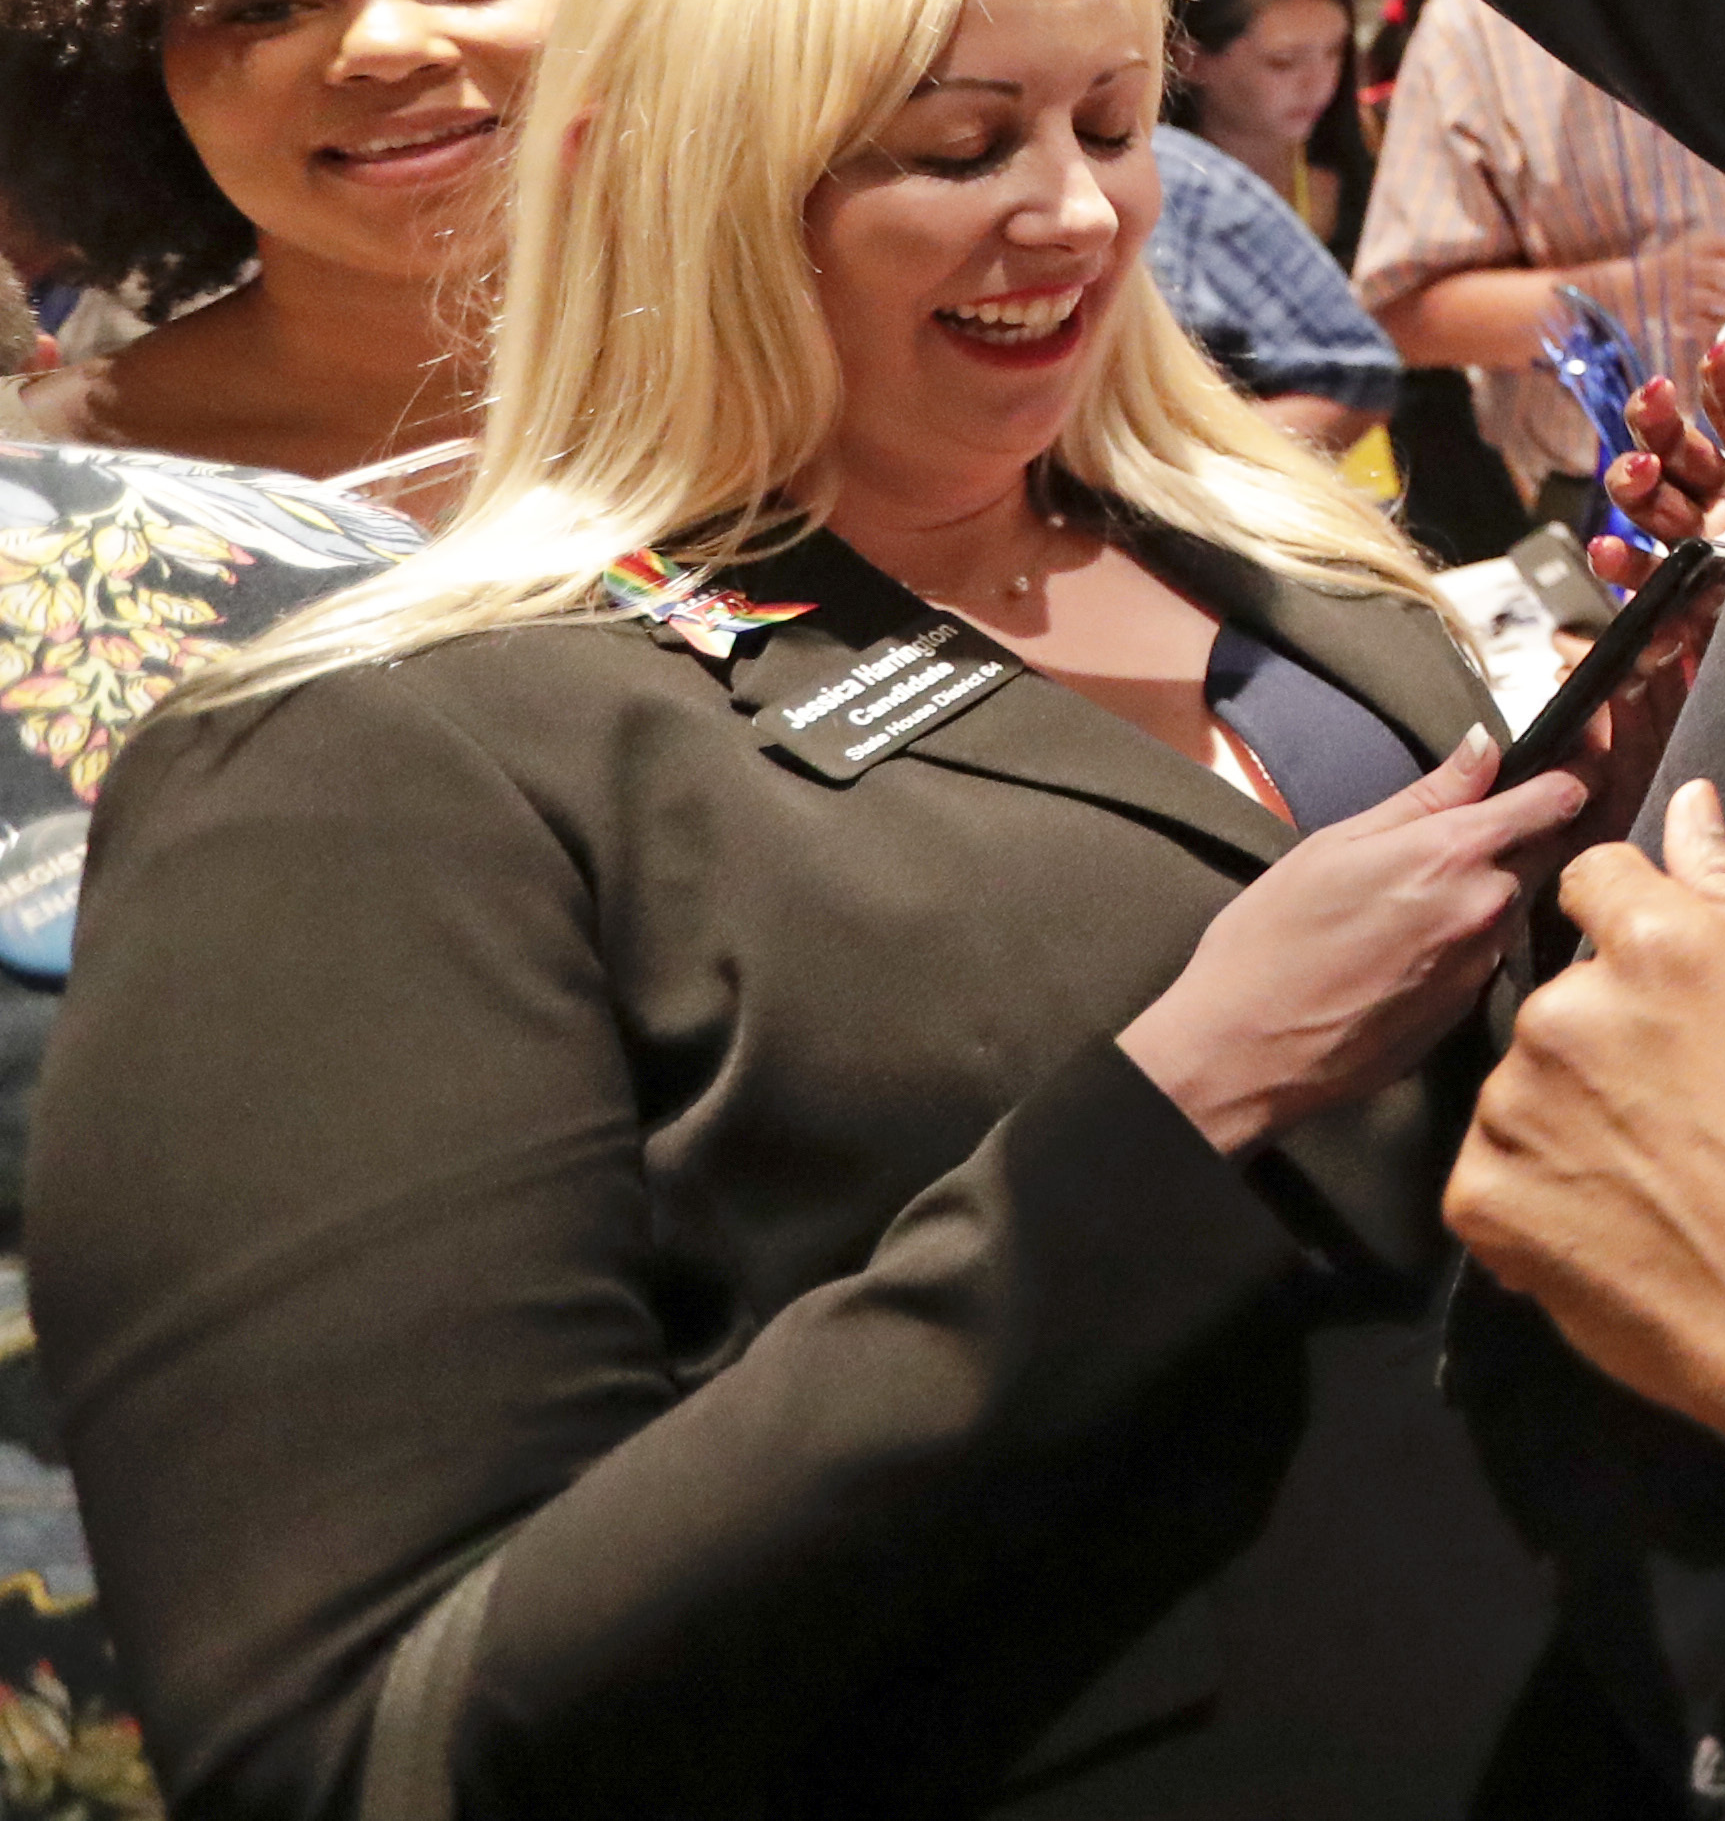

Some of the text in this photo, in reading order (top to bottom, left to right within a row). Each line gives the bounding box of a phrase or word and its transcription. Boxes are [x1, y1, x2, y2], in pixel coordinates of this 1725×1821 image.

[782, 623, 959, 729] Jessica Harrington
[844, 732, 892, 761] State
[884, 703, 938, 737] House
[931, 672, 986, 708] District
[848, 661, 955, 725] Candidate
